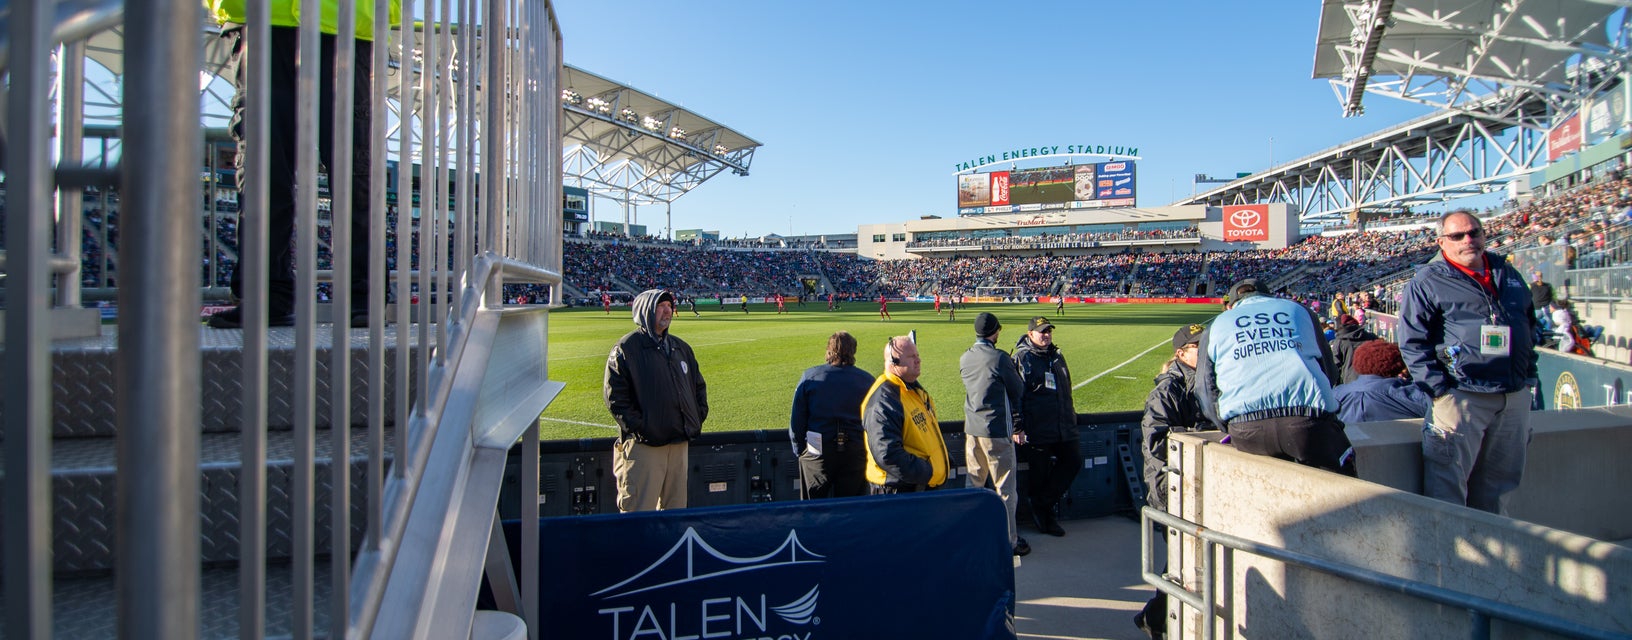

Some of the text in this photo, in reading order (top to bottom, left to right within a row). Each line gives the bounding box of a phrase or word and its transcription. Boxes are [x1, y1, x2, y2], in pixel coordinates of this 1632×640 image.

[955, 145, 1139, 172] TALEN ENERGY STADIUM
[1235, 312, 1291, 328] CSC
[1236, 327, 1295, 344] EVENT
[1233, 339, 1303, 361] SUPERVISOR
[598, 593, 767, 640] TALEN
